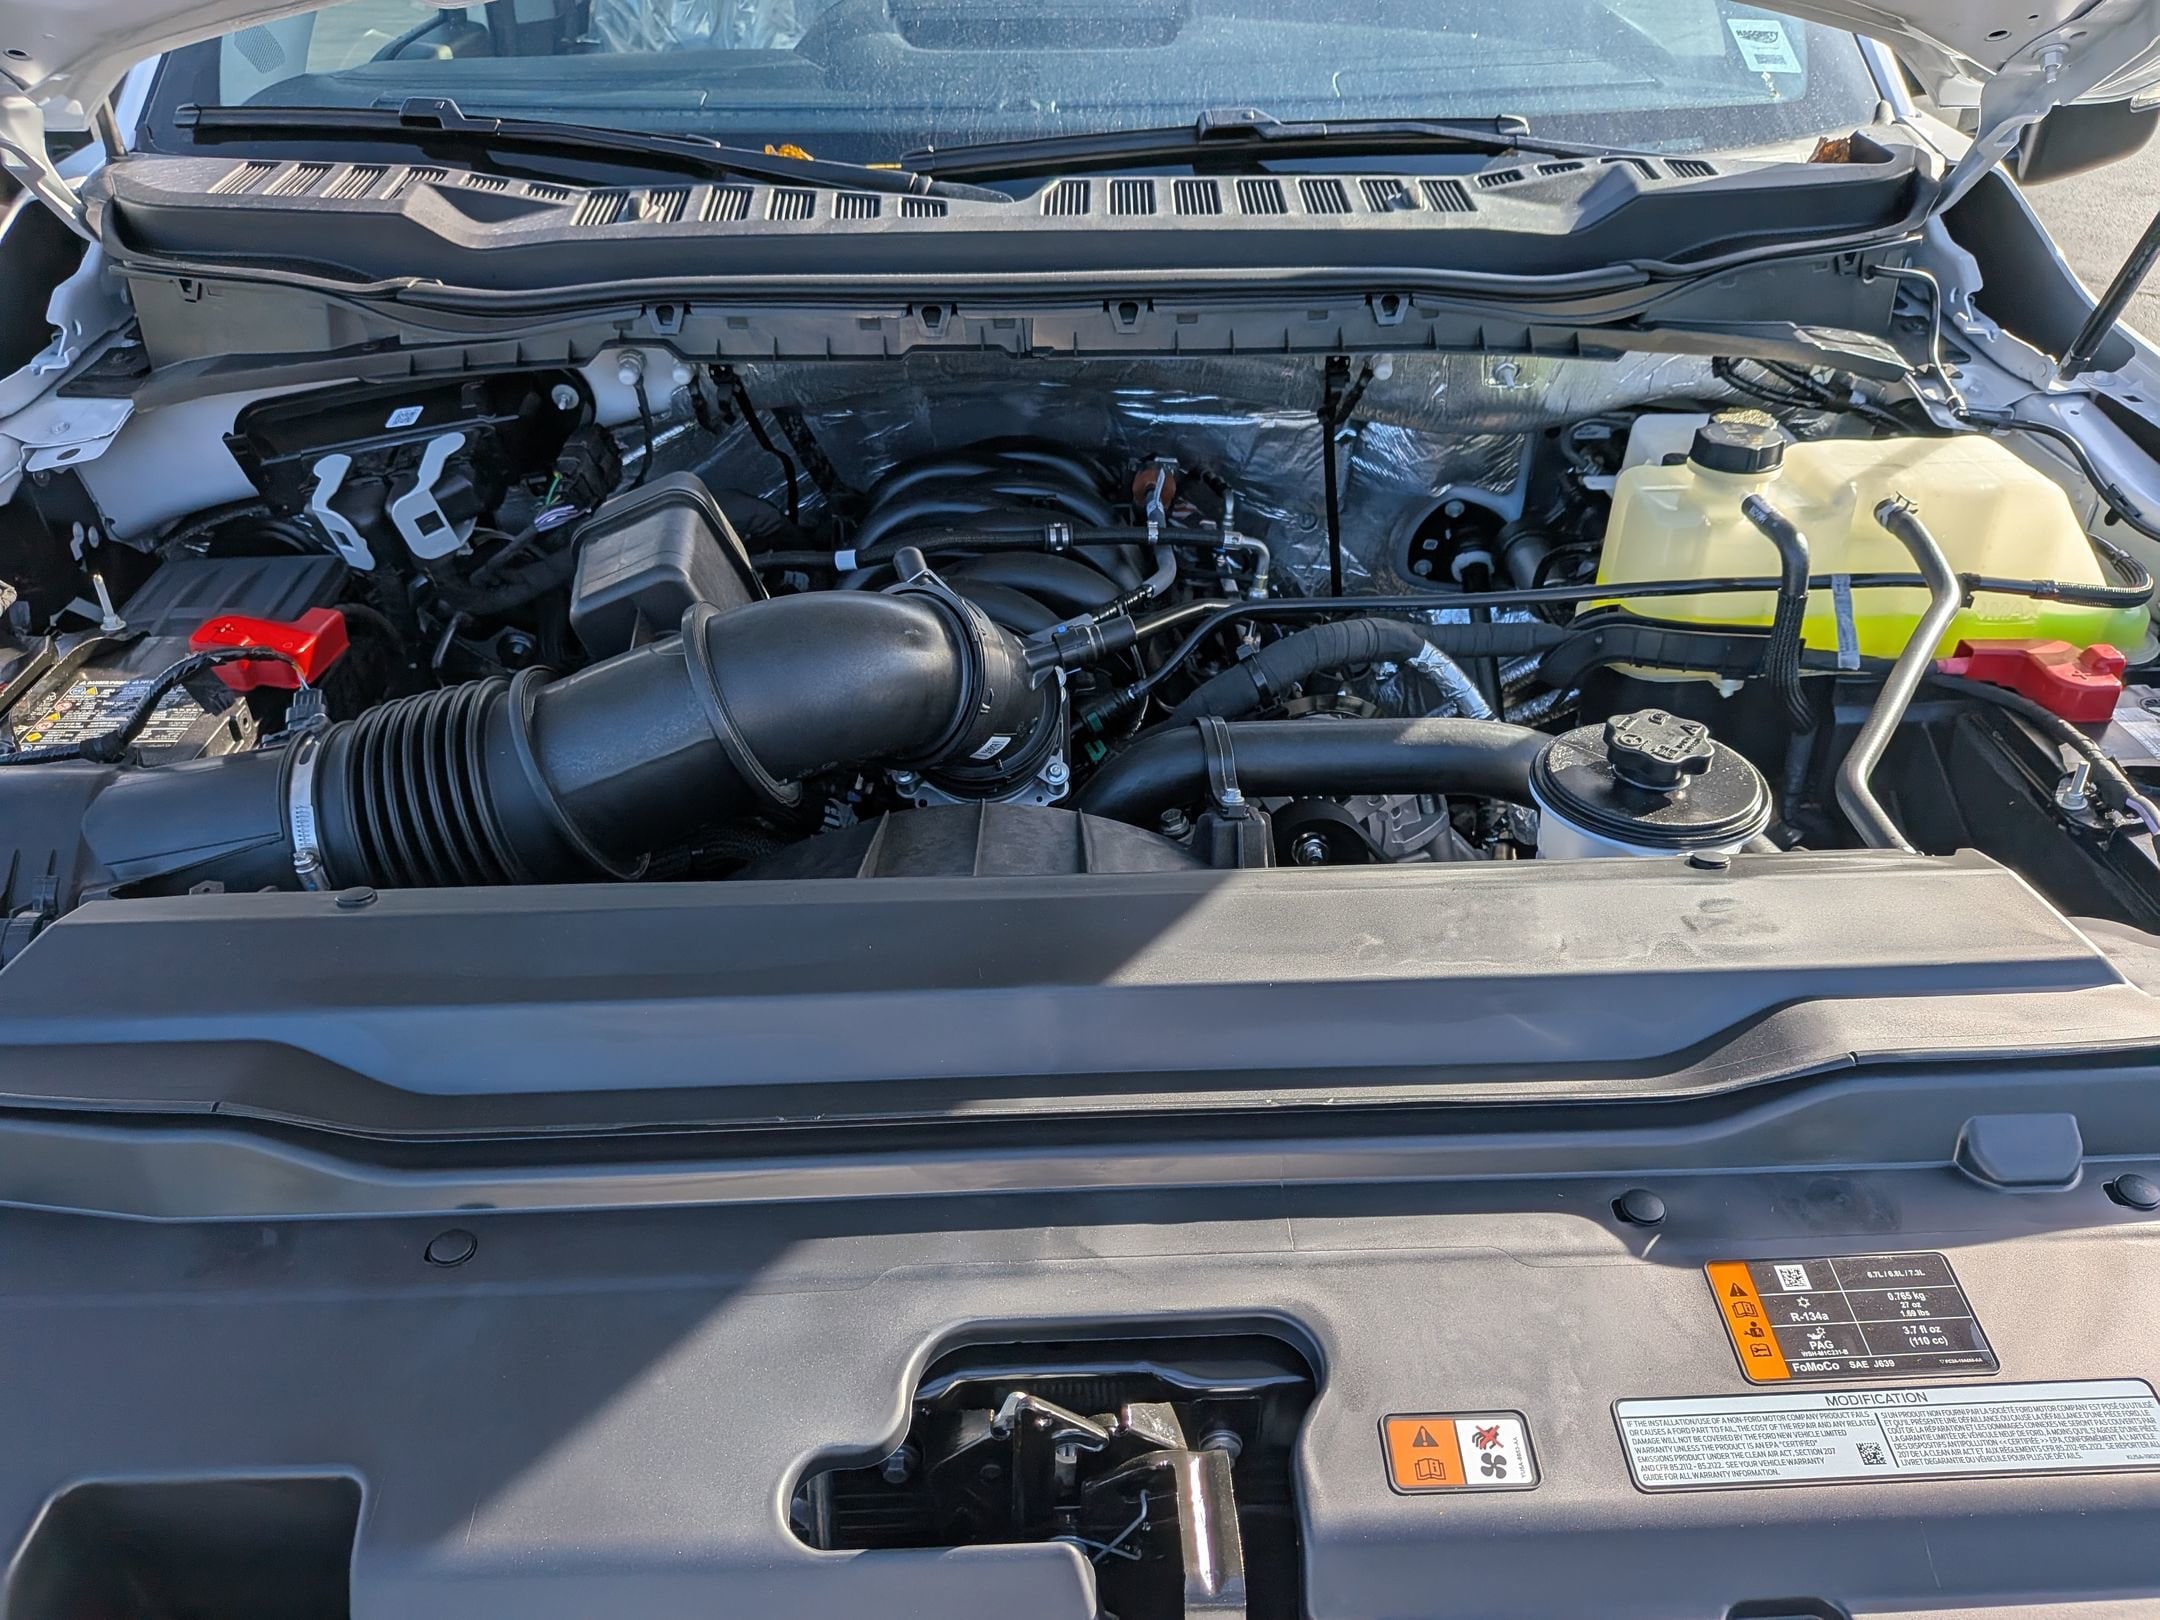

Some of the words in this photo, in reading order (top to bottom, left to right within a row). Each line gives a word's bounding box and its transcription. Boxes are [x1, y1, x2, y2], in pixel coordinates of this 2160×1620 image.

[1887, 1291, 1912, 1301] 0.765
[1912, 1291, 1927, 1301] kg
[1790, 1311, 1829, 1322] R-134a
[1902, 1325, 1917, 1335] 3.7
[1919, 1325, 1927, 1334] fl
[1929, 1325, 1942, 1333] oz
[1808, 1340, 1834, 1350] PAG
[1909, 1336, 1930, 1347] (110
[1931, 1335, 1948, 1346] cc)
[1792, 1361, 1840, 1373] FoMoCo
[1848, 1360, 1870, 1369] SAE
[1873, 1359, 1895, 1368] J639
[1825, 1392, 1928, 1406] MODIFICATION
[1846, 1419, 1876, 1427] RELATED
[1634, 1446, 1674, 1454] WARRANTY
[1637, 1455, 1674, 1463] EMISSIONS
[1794, 1448, 1824, 1456] SECTION
[1786, 1457, 1826, 1465] WARRANTY
[1692, 1471, 1732, 1479] WARRANTY
